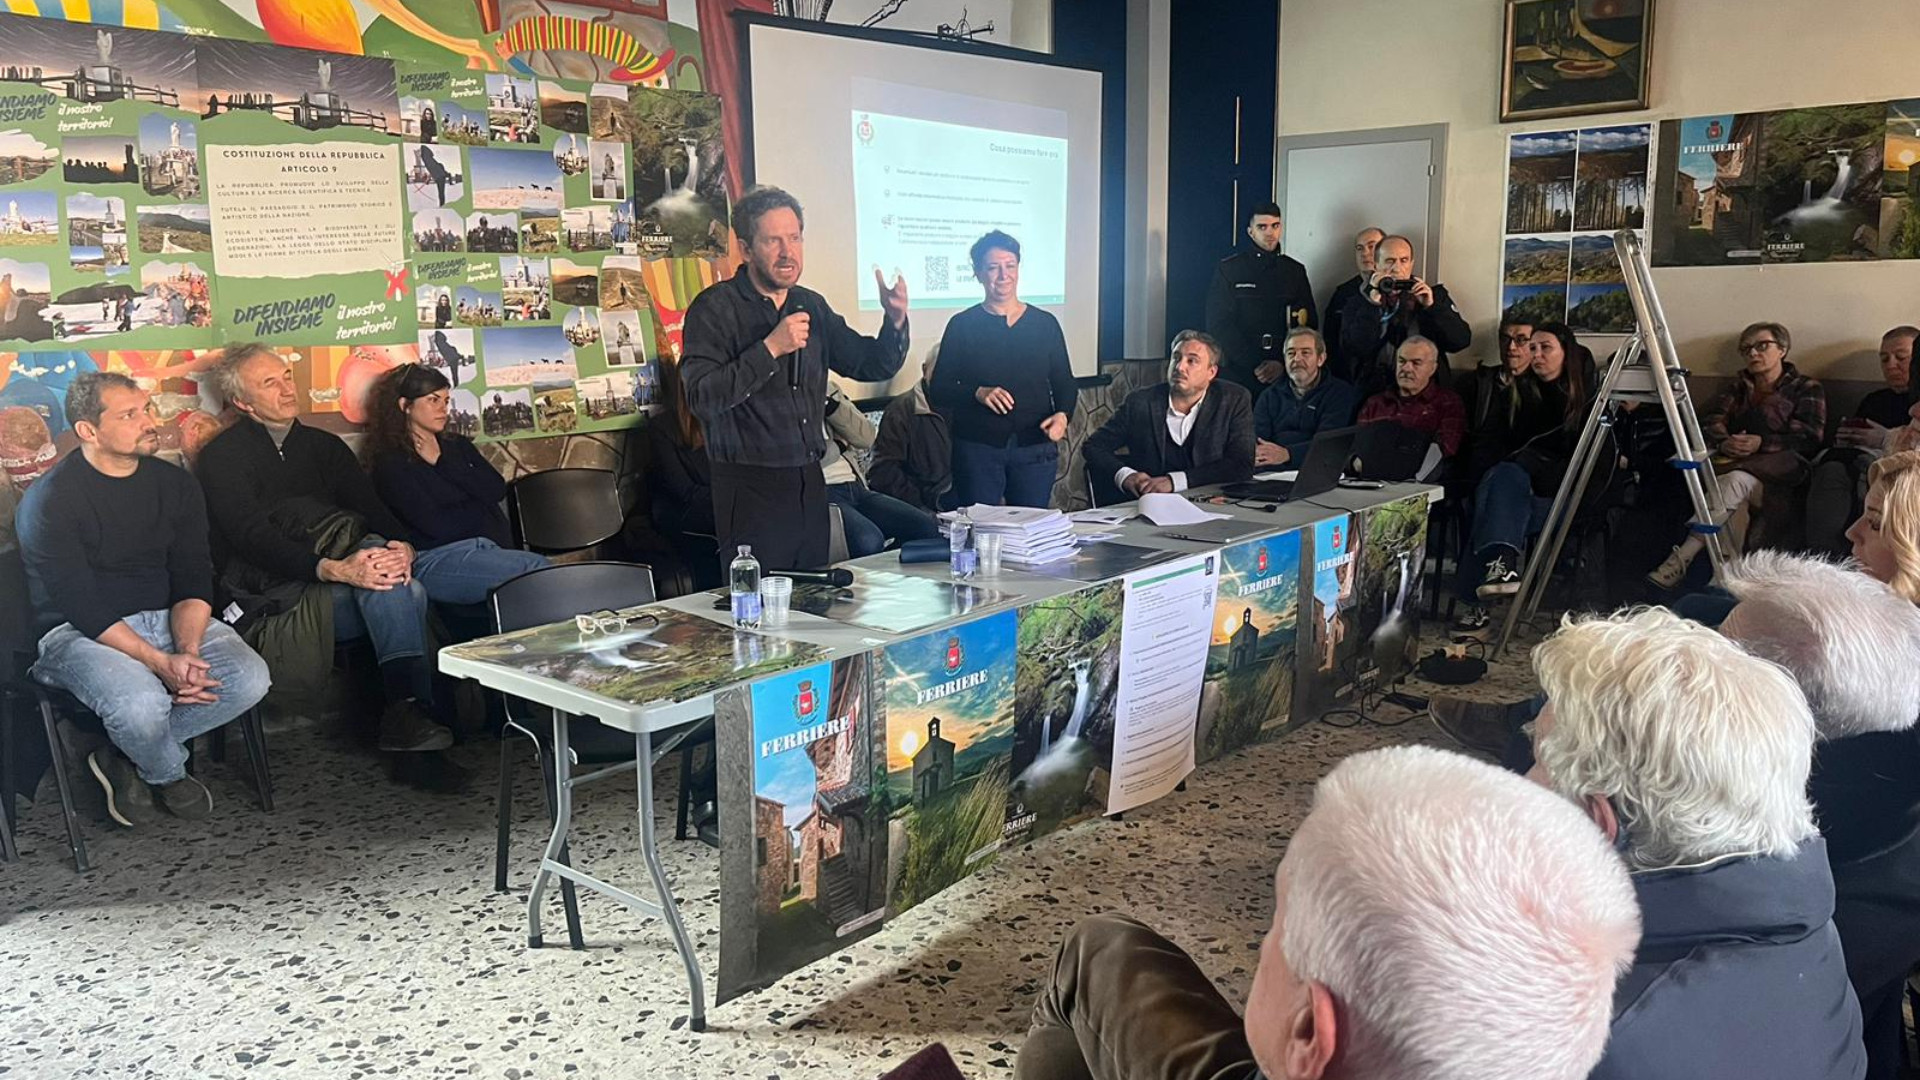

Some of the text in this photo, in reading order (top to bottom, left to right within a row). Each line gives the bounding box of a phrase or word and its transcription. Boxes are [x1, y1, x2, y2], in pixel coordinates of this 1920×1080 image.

[0, 92, 58, 108] NDIAMO
[58, 102, 102, 116] il nostro
[57, 116, 114, 132] territorio!
[1683, 142, 1744, 154] FERRIERE
[233, 293, 336, 325] DIFENDIAMO
[336, 300, 386, 320] il nostro
[254, 311, 324, 337] INSIEME
[336, 316, 398, 340] territorio!
[1317, 552, 1355, 572] FERRIERE
[1238, 574, 1284, 597] FERRIERE
[916, 668, 990, 706] FERRIERE
[760, 714, 851, 758] FERRIERE
[1002, 812, 1038, 831] ERRIERE
